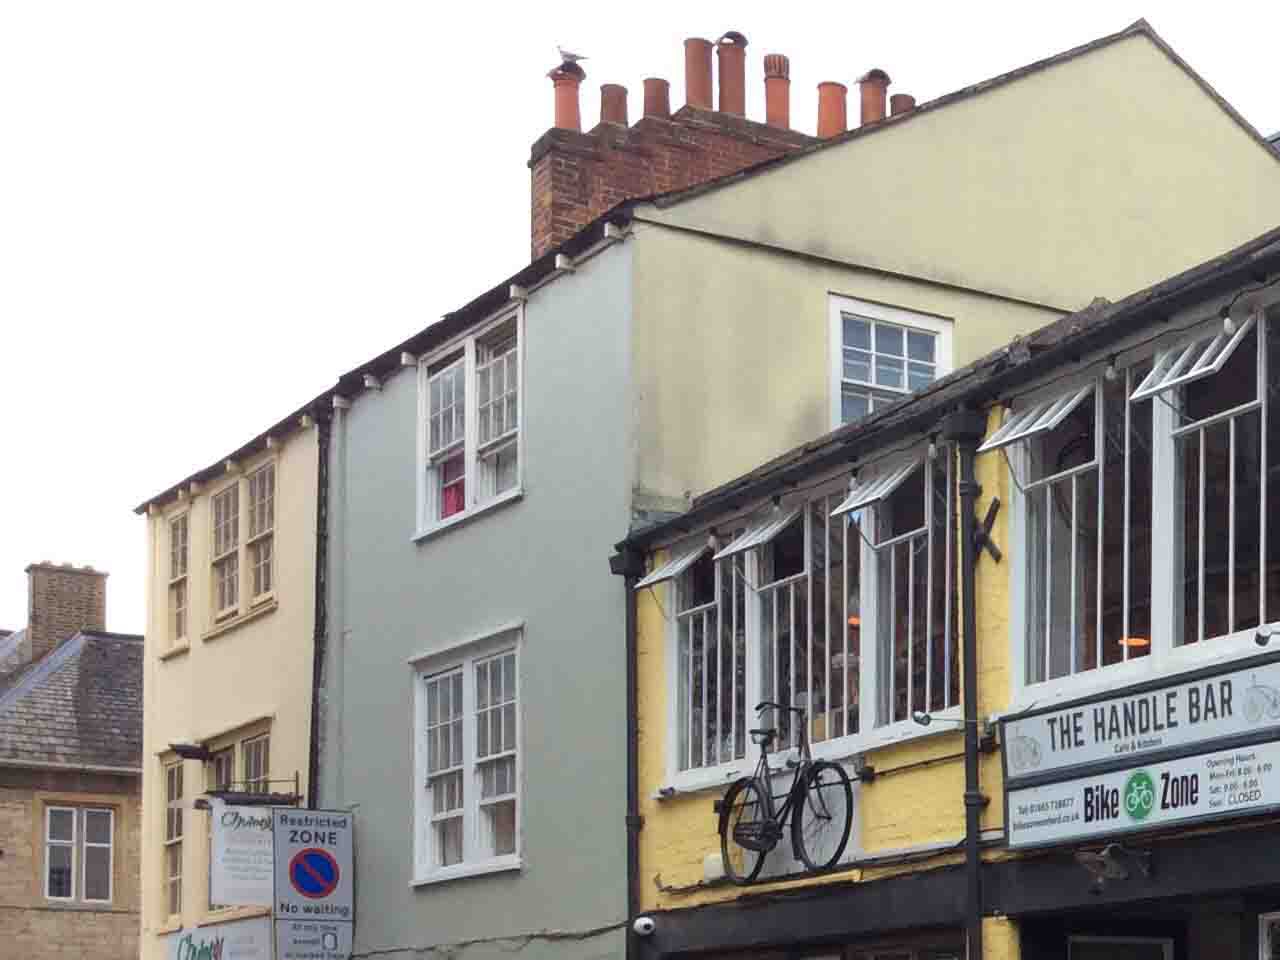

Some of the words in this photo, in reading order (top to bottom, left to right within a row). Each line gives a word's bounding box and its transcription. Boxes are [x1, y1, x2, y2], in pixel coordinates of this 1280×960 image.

[1047, 711, 1085, 752] THE
[1093, 690, 1179, 745] HANDLE
[1188, 679, 1233, 725] BAR
[1083, 783, 1120, 823] Bike
[1160, 772, 1199, 810] Zone
[1227, 790, 1262, 805] CLOSED
[280, 814, 347, 829] Restricted
[289, 830, 337, 845] ZONE
[280, 903, 298, 914] No
[303, 903, 349, 917] waiting
